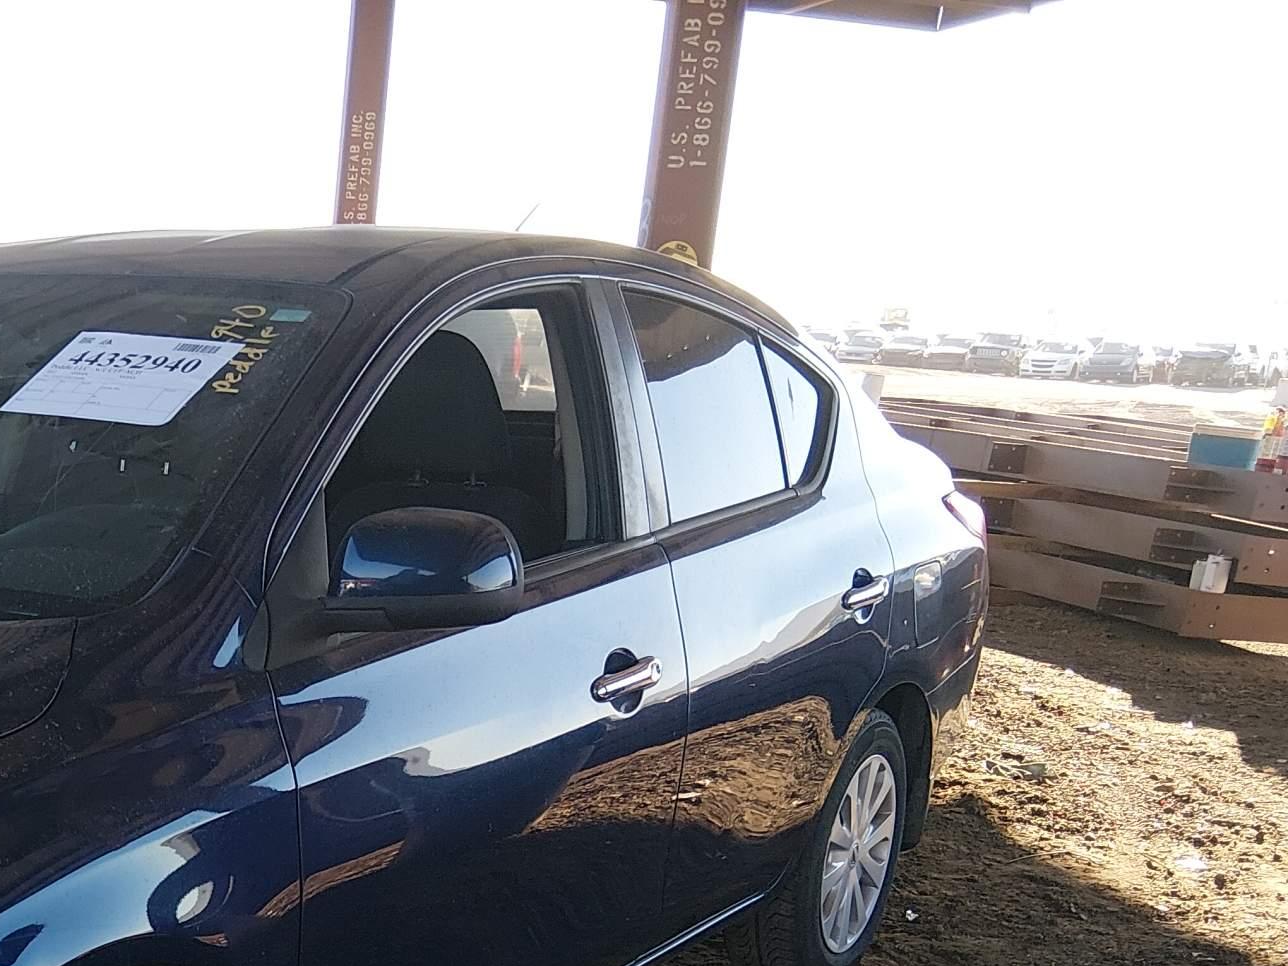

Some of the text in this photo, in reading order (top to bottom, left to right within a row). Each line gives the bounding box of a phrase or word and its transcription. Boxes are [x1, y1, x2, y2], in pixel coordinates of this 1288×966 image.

[675, 17, 702, 110] PREFAB
[351, 110, 364, 138] INC.
[667, 124, 690, 169] U.S.
[345, 144, 360, 200] PREFAB
[68, 350, 202, 374] 44352940
